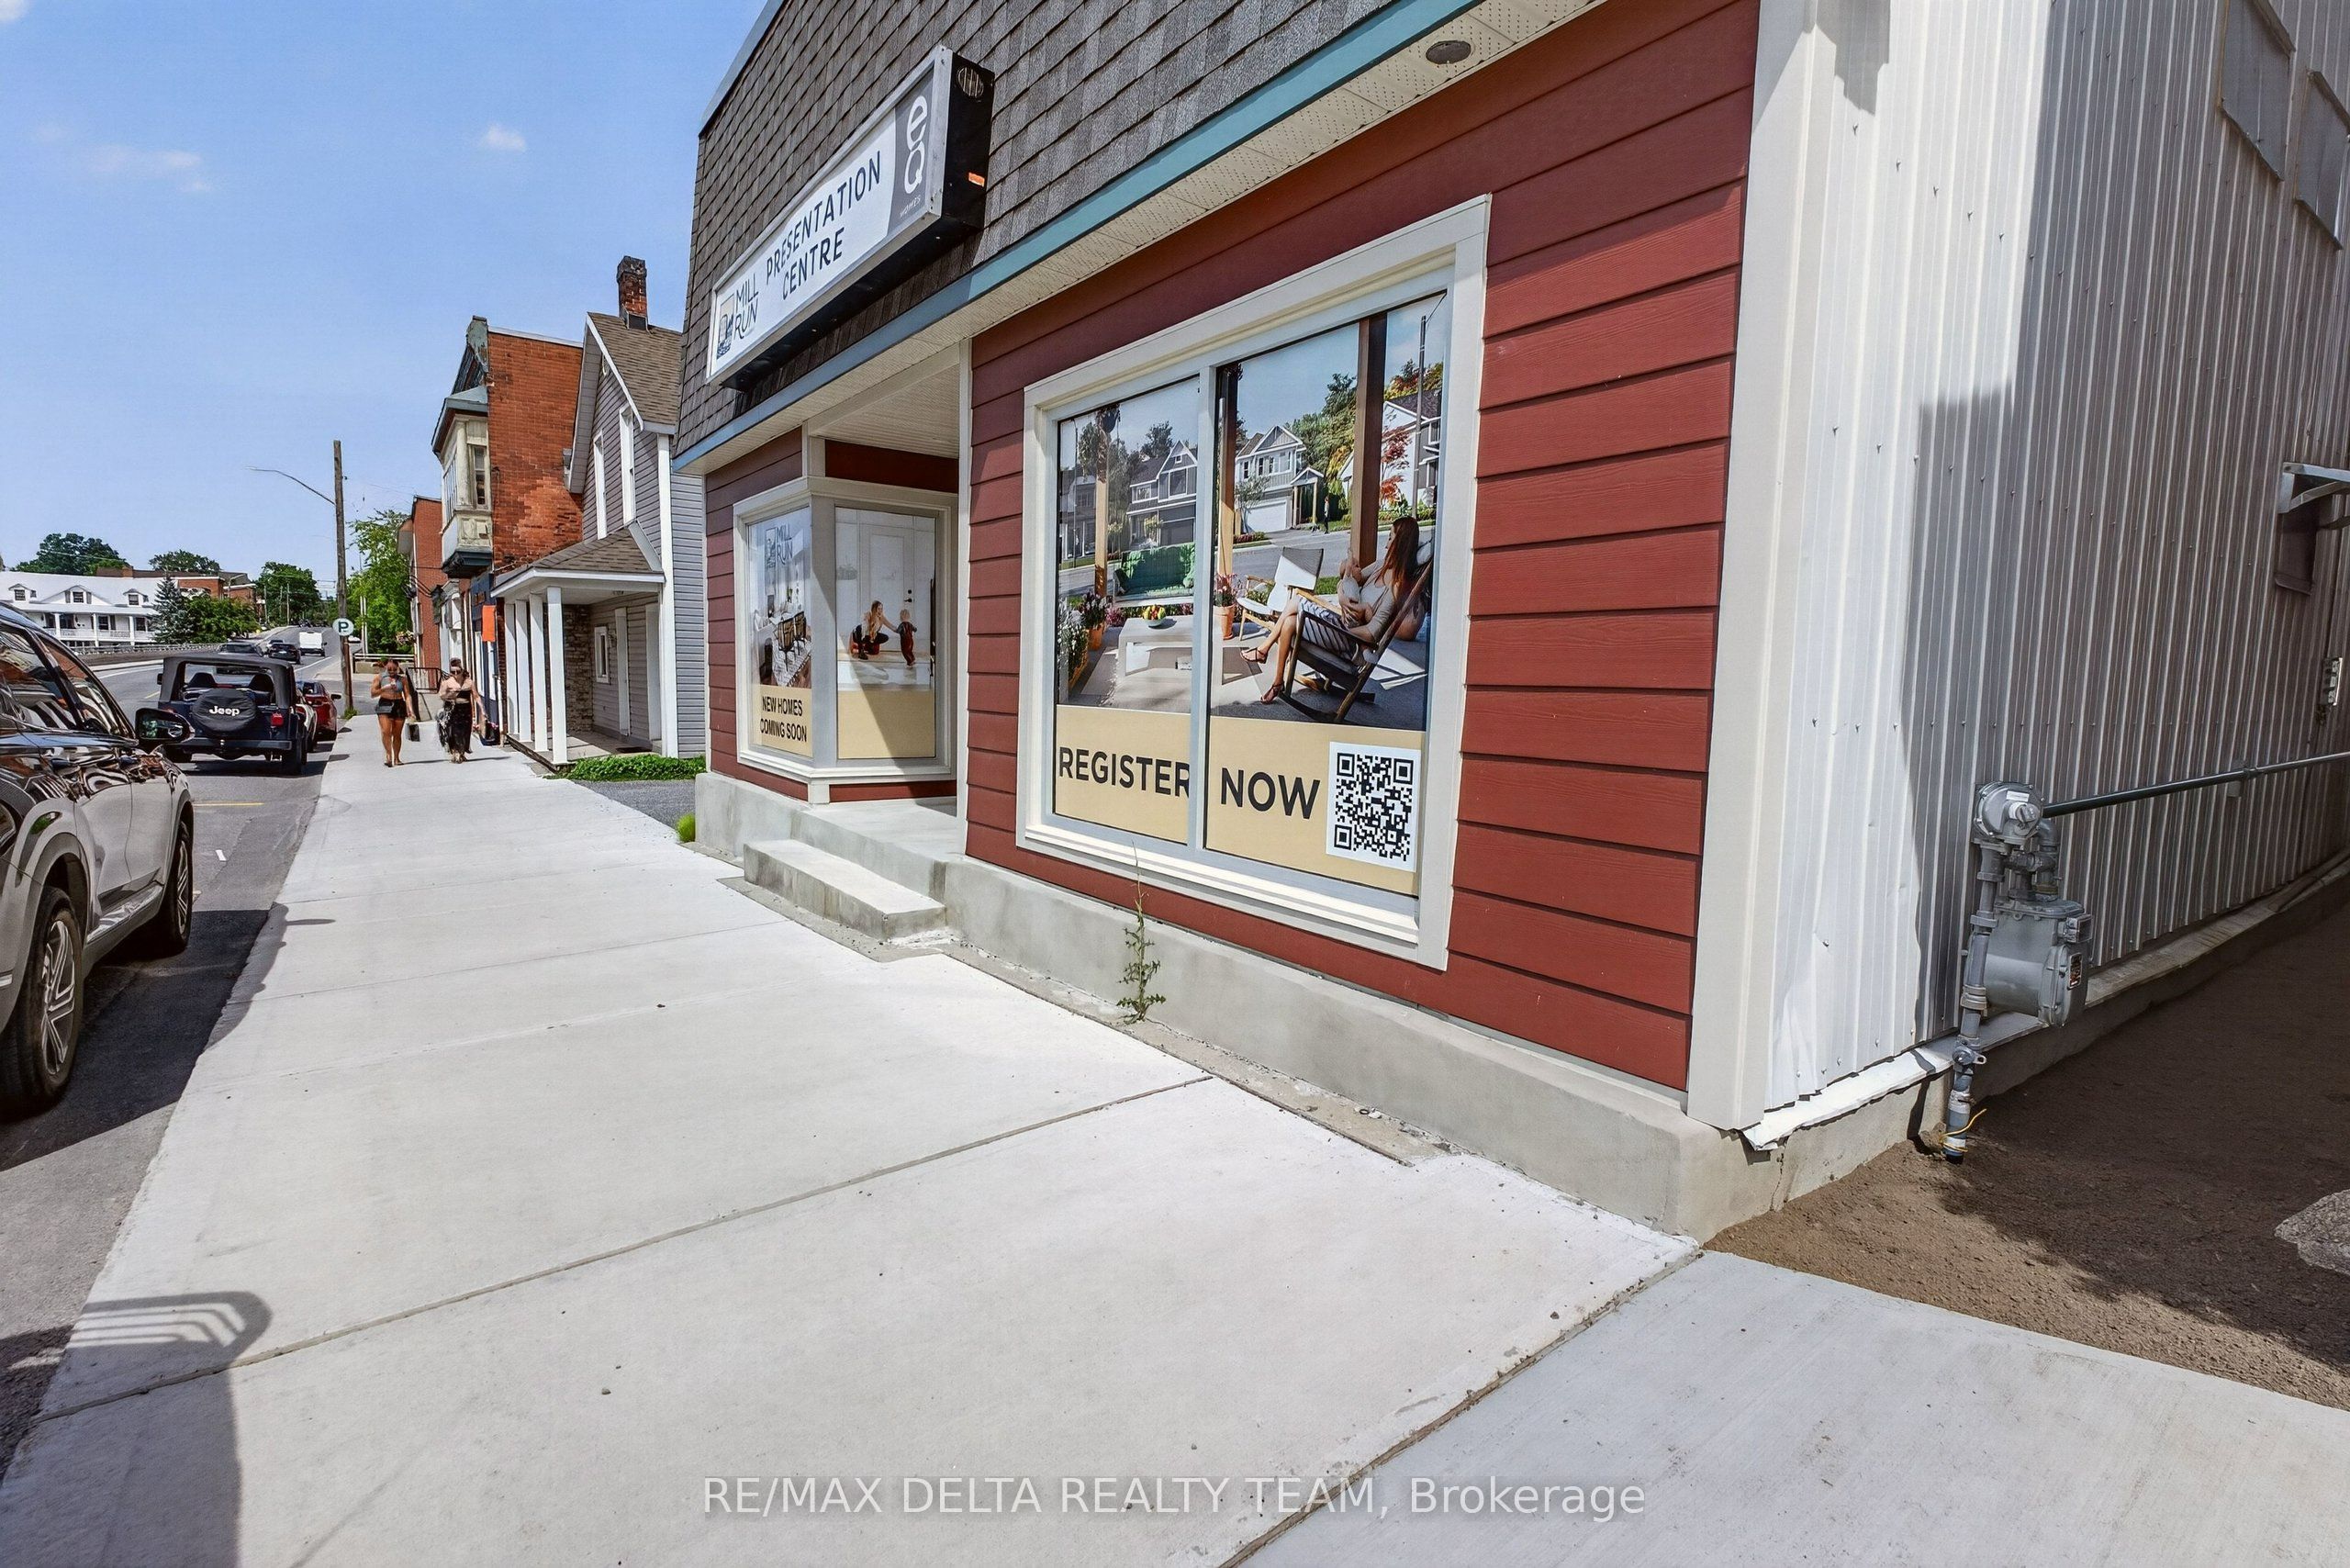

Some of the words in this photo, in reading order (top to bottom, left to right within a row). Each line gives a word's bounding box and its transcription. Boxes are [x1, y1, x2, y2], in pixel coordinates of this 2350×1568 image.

[767, 151, 880, 286] PRESENTATION
[782, 227, 845, 300] CENTRE
[736, 273, 759, 312] MILL
[734, 297, 758, 340] RUN
[209, 705, 240, 716] Jeep
[762, 696, 777, 712] NEW
[778, 698, 803, 716] HOMES
[760, 718, 785, 738] COMING
[786, 722, 808, 742] SOON
[1058, 746, 1190, 798] REGISTER
[1220, 767, 1321, 820] NOW
